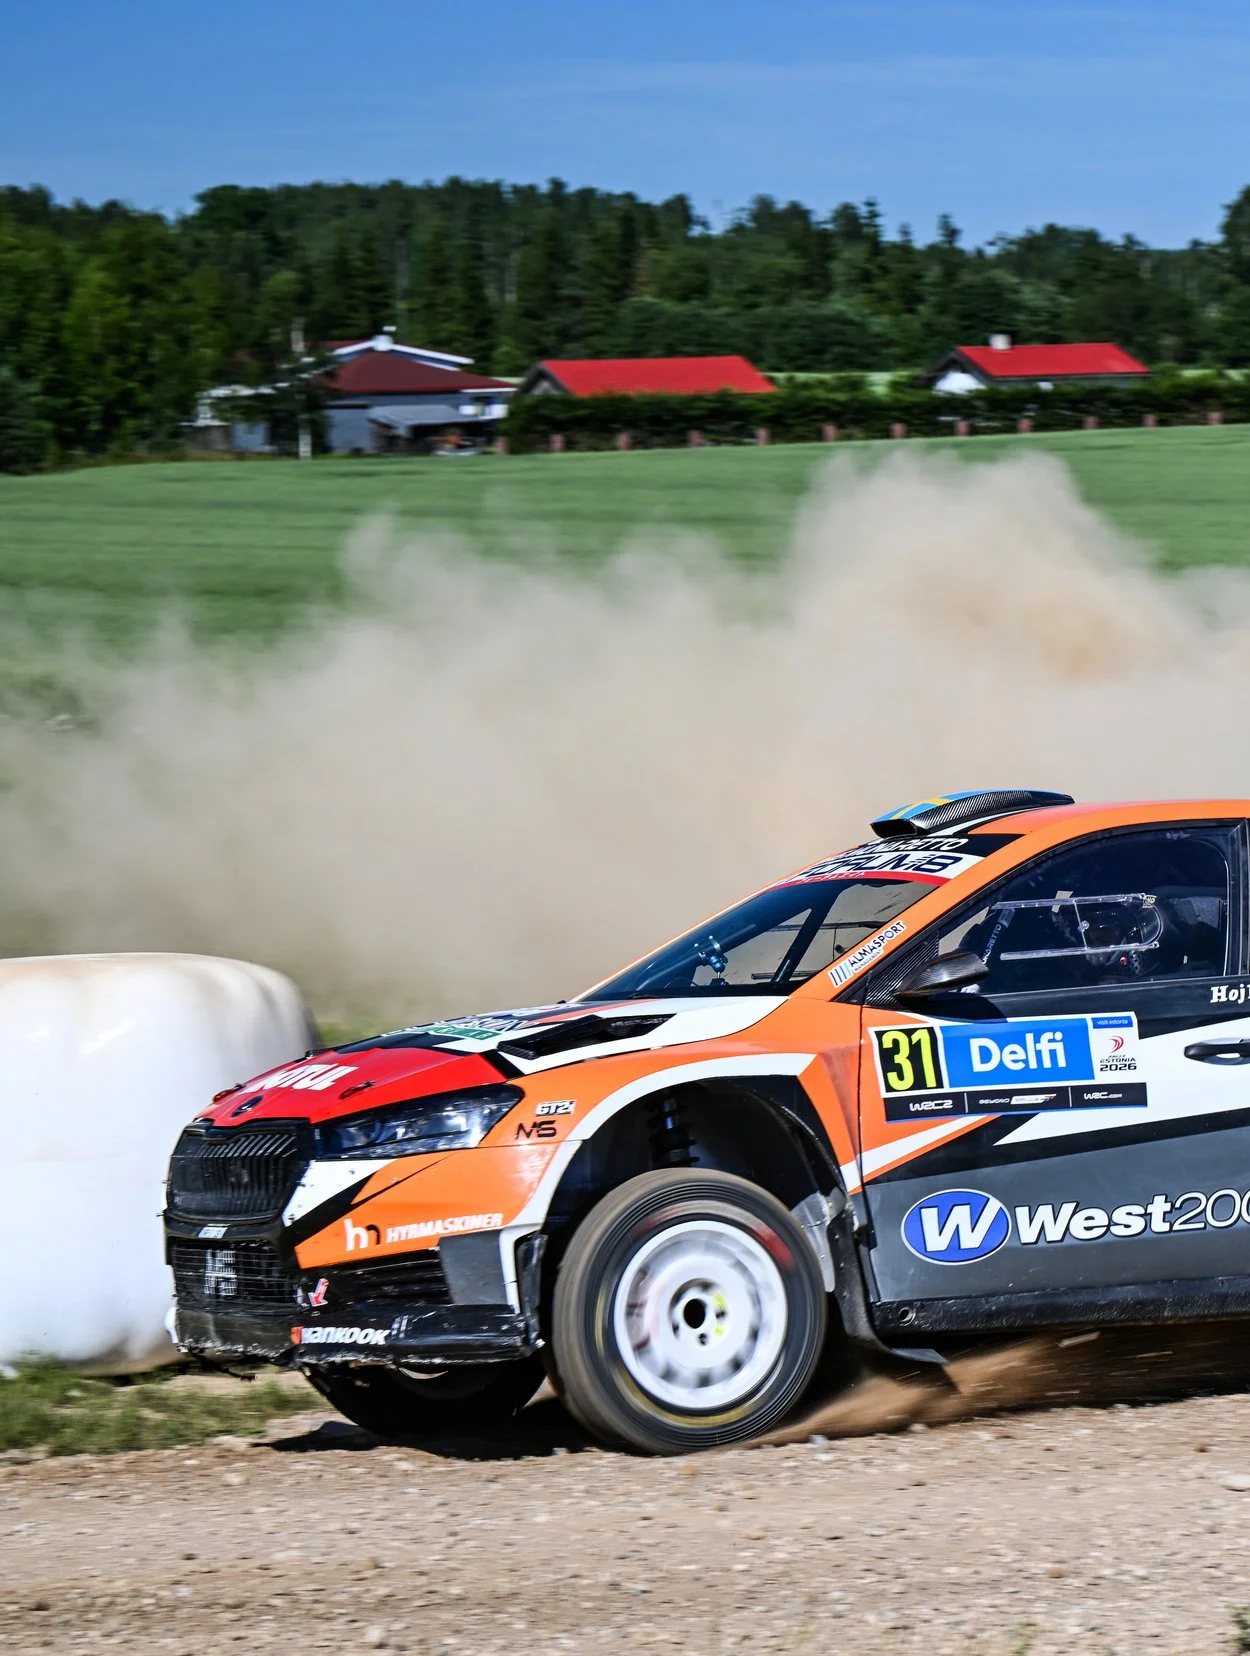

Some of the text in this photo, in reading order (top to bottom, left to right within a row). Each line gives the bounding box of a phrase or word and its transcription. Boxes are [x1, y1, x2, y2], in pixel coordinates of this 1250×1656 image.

[848, 921, 906, 967] ALMASPORT
[881, 1028, 938, 1092] 31
[969, 1031, 1067, 1073] Delfi
[1100, 1056, 1137, 1064] ESTONIA
[1100, 1062, 1138, 1072] 2026
[909, 1099, 954, 1112] WRC2
[386, 1213, 504, 1244] HYRMASKINER
